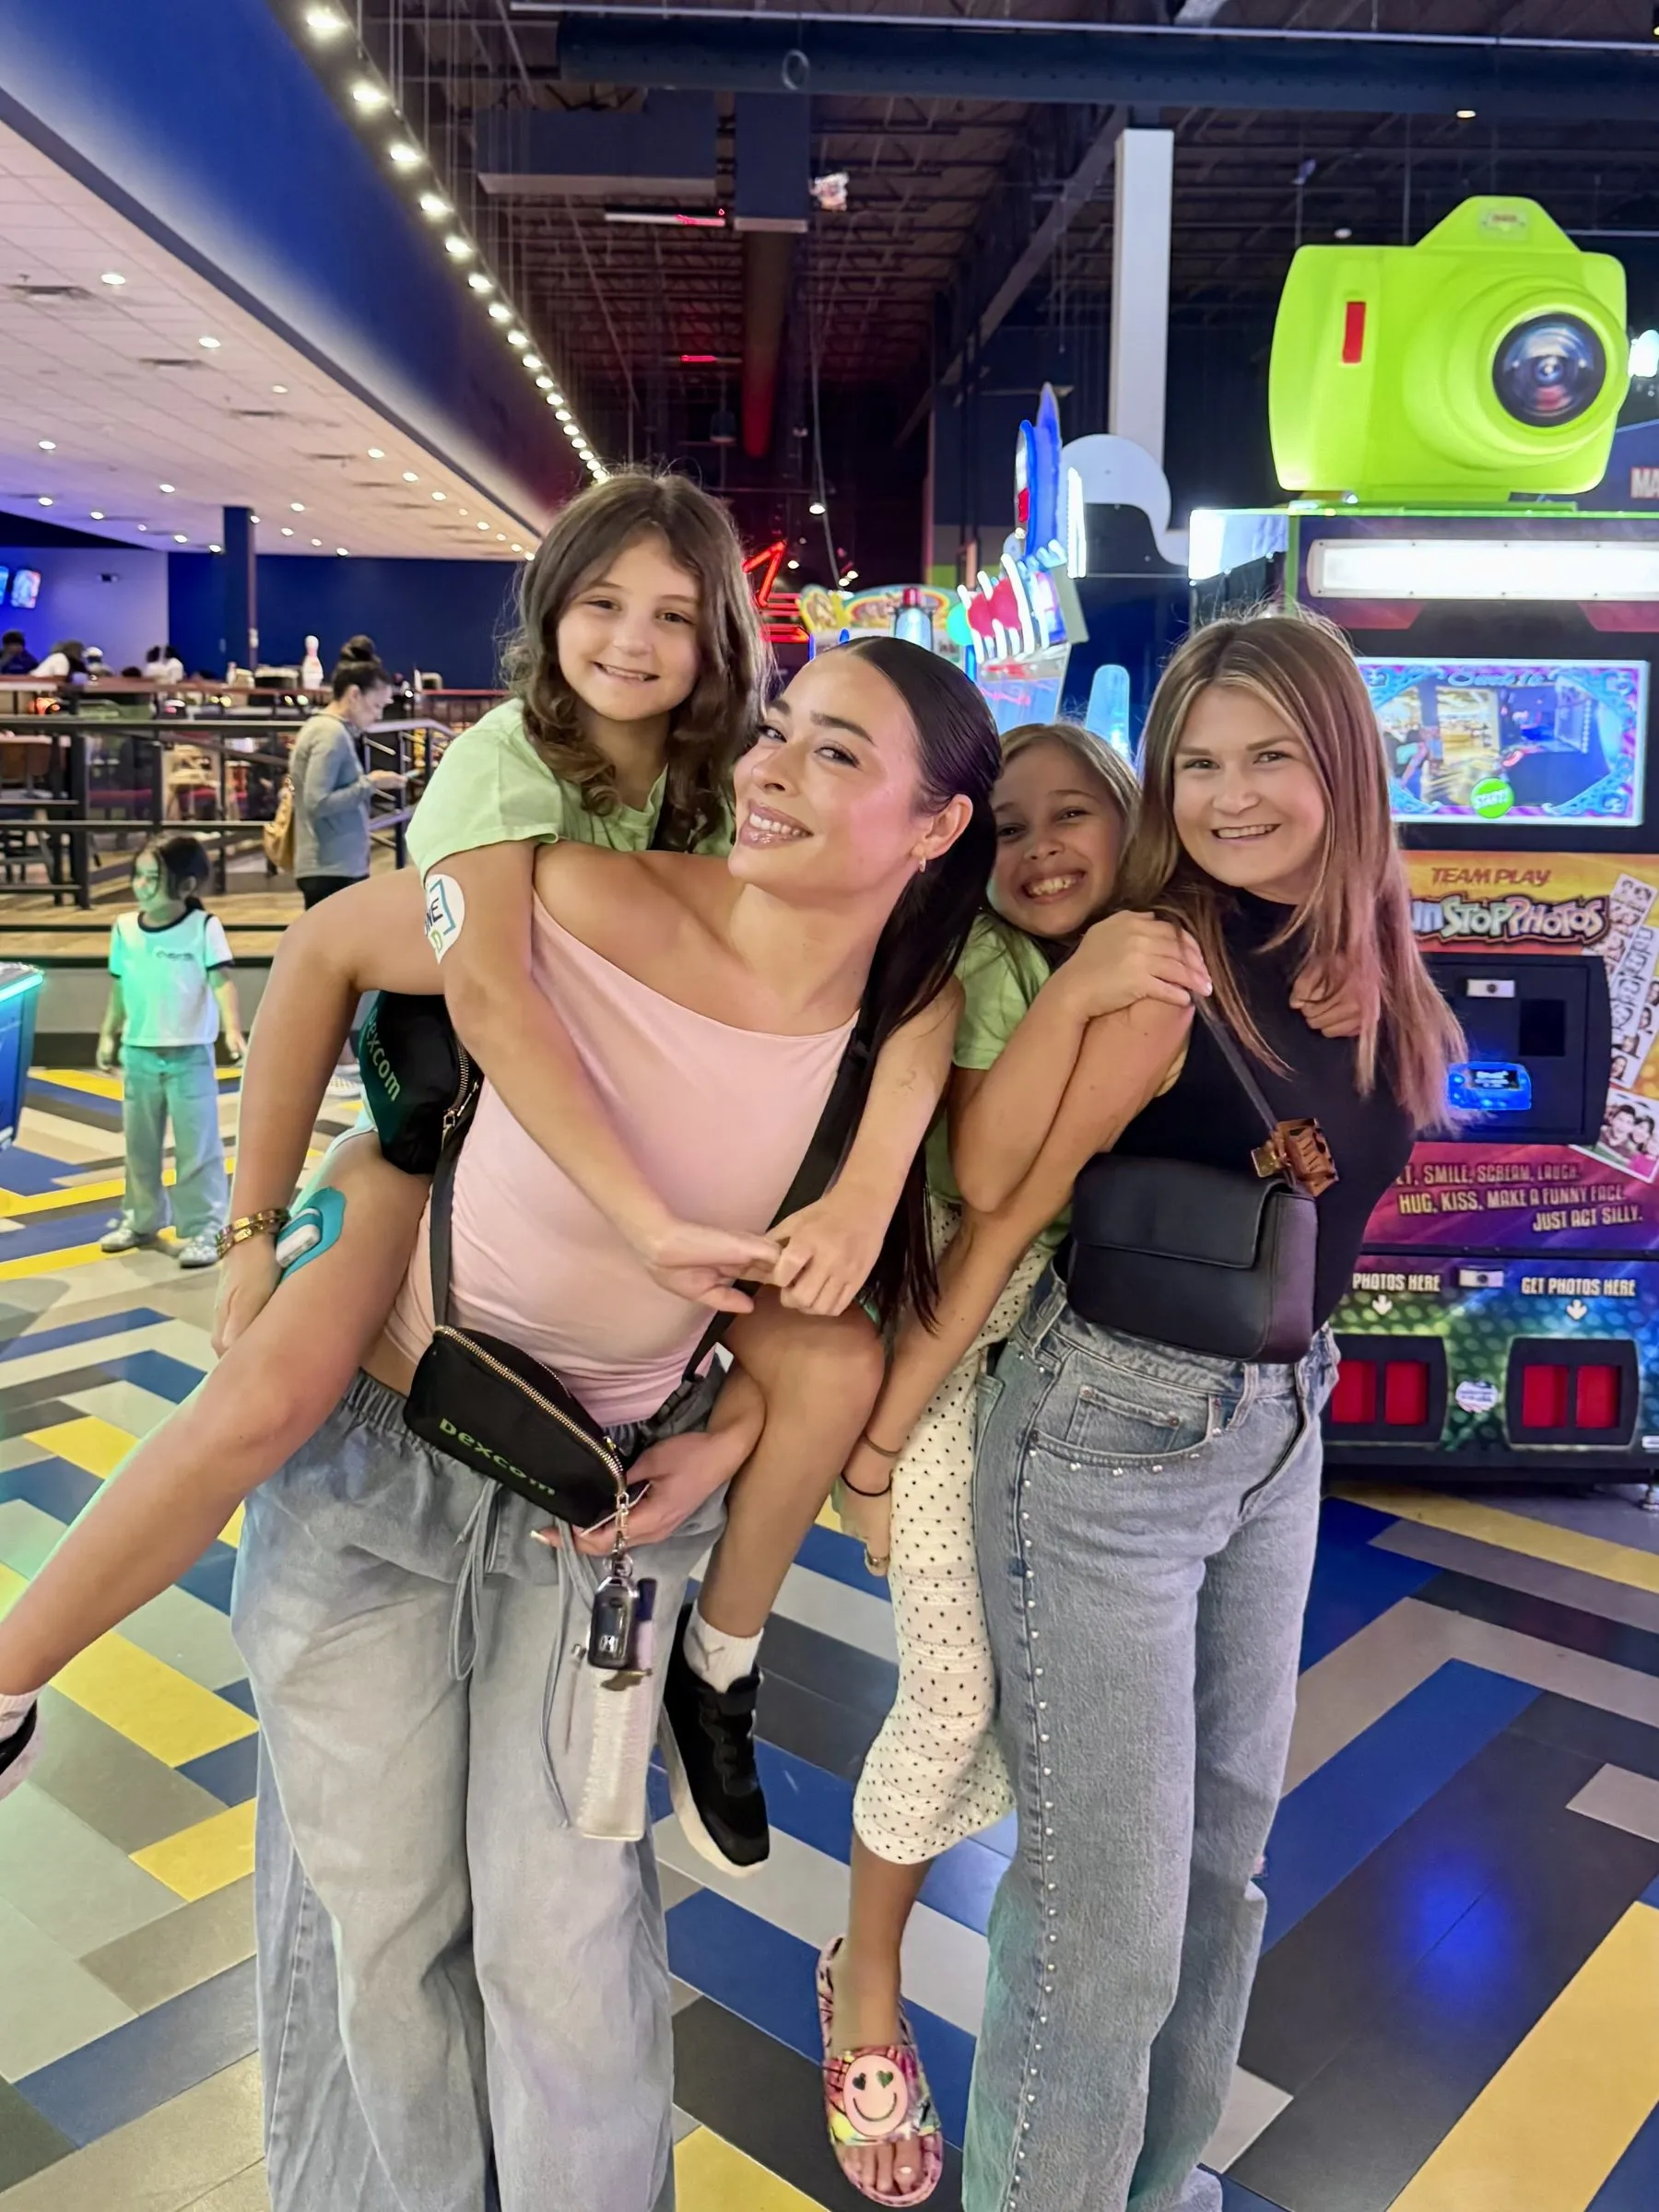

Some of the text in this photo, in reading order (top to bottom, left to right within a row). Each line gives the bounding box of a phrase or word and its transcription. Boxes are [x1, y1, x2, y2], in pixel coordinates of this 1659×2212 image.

[1431, 867, 1552, 887] TEAM PLAY
[1423, 1164, 1474, 1185] SMILE.
[1477, 1164, 1535, 1182] SCREAM.
[1441, 1192, 1484, 1212] KISS.
[1487, 1190, 1527, 1208] MAKE
[1530, 1188, 1539, 1206] A
[1542, 1186, 1586, 1205] FUNNY
[1533, 1205, 1643, 1231] JUST ACT SILLY.
[1352, 1273, 1441, 1291] PHOTOS HERE
[1522, 1277, 1636, 1296] GET PHOTOS HERE
[440, 1418, 555, 1495] Dexcom
